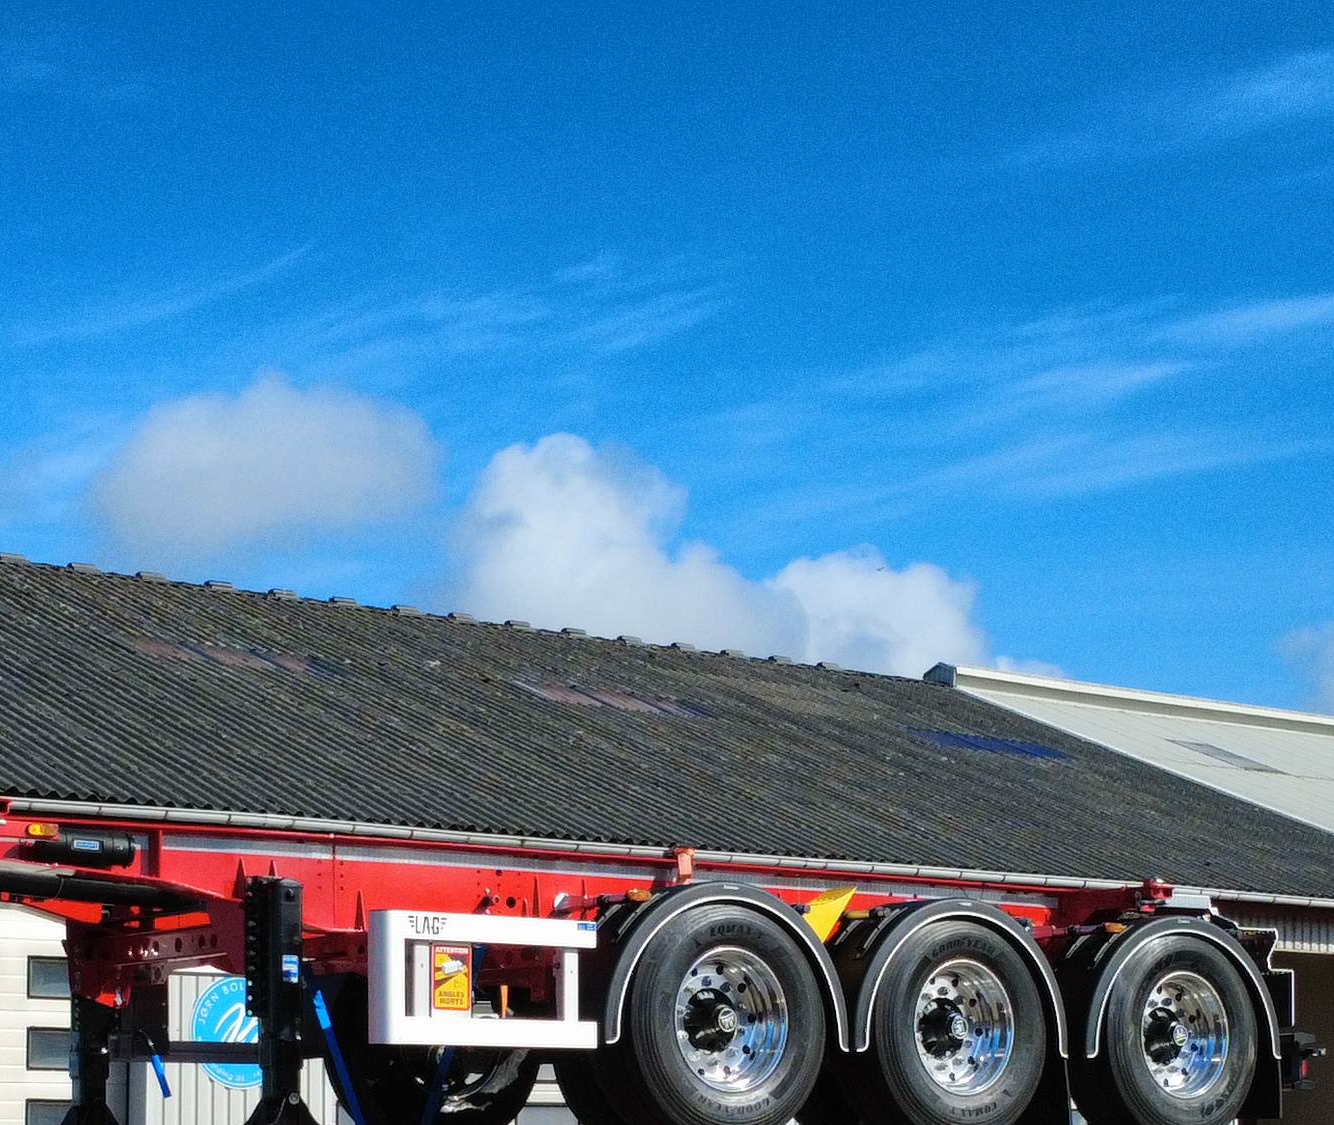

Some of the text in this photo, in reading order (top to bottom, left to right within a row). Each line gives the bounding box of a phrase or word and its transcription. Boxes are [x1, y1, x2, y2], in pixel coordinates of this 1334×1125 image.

[413, 915, 441, 935] LAG
[198, 982, 246, 1025] JØRN BOL
